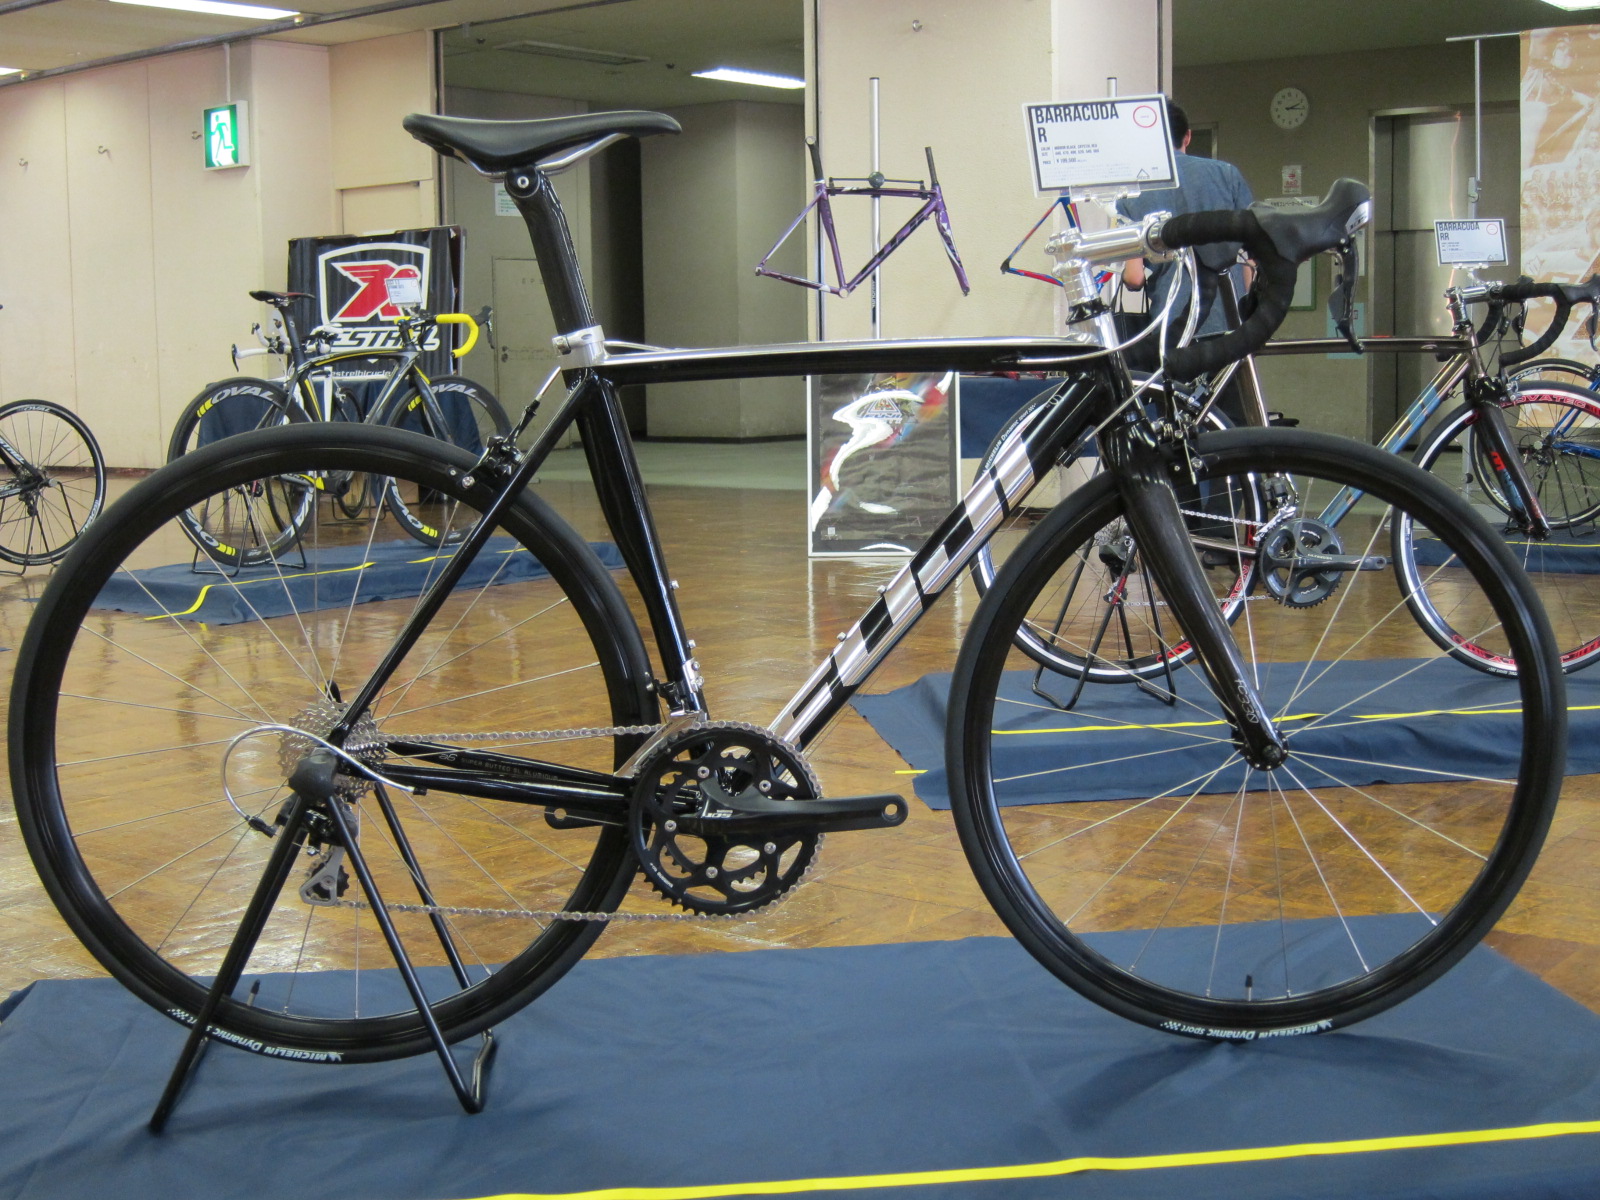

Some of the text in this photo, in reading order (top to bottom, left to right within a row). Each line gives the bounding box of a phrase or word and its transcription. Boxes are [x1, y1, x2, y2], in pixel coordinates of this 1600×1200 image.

[1035, 104, 1119, 123] BARRACUDA
[1038, 127, 1048, 143] R
[1438, 222, 1480, 232] BARRACUDA
[1440, 232, 1450, 241] RR
[211, 385, 275, 405] OVAL
[984, 439, 1003, 470] MICHELIN
[1000, 419, 1019, 441] Dynamic
[1181, 1025, 1207, 1037] sport
[1206, 1028, 1256, 1040] Dynamic
[212, 1027, 263, 1052] Dynamic
[263, 1046, 328, 1061] MICHELIN
